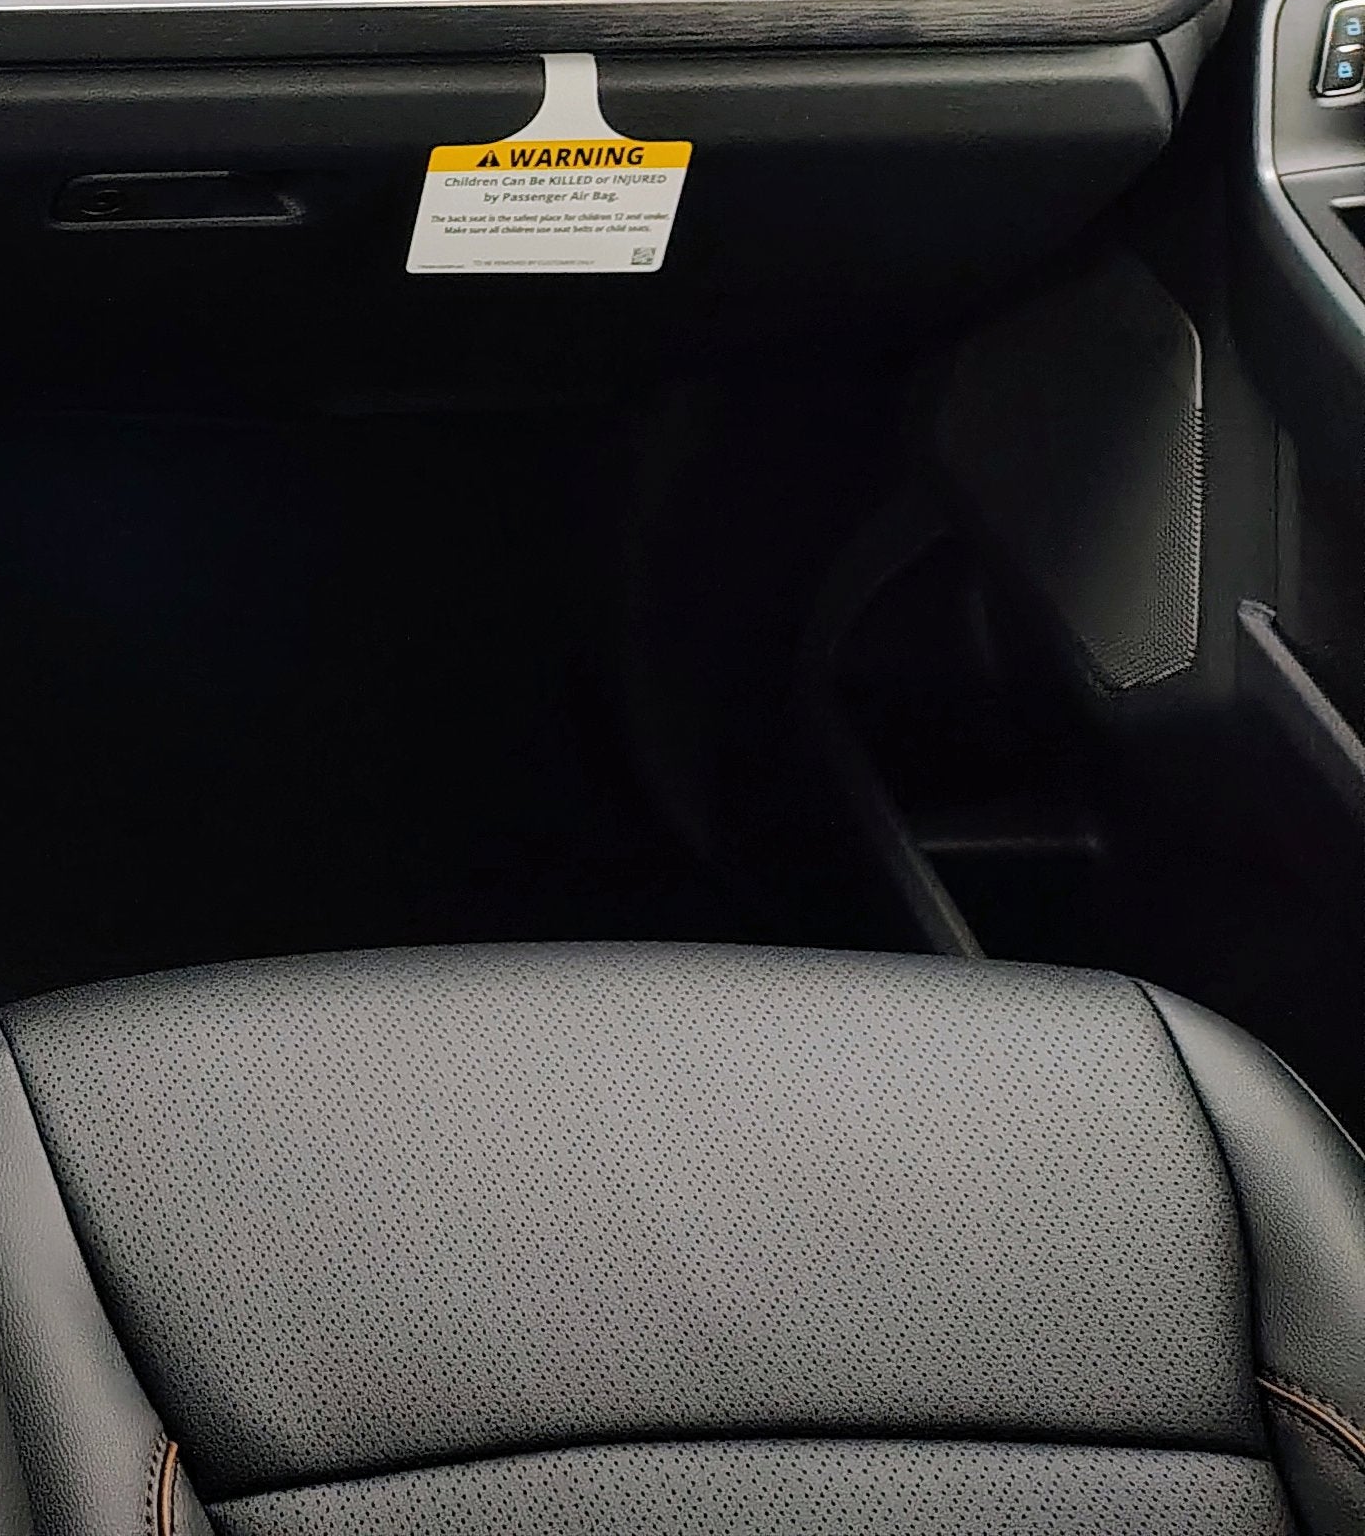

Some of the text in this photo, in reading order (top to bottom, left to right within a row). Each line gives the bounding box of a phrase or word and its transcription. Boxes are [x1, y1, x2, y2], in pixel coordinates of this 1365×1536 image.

[509, 147, 644, 168] WARNING
[444, 177, 498, 187] Children
[502, 177, 526, 187] Can
[530, 176, 546, 185] Be
[549, 175, 593, 185] KILLED
[613, 174, 667, 186] INJURED
[483, 191, 619, 204] by Passenger Air Bag.
